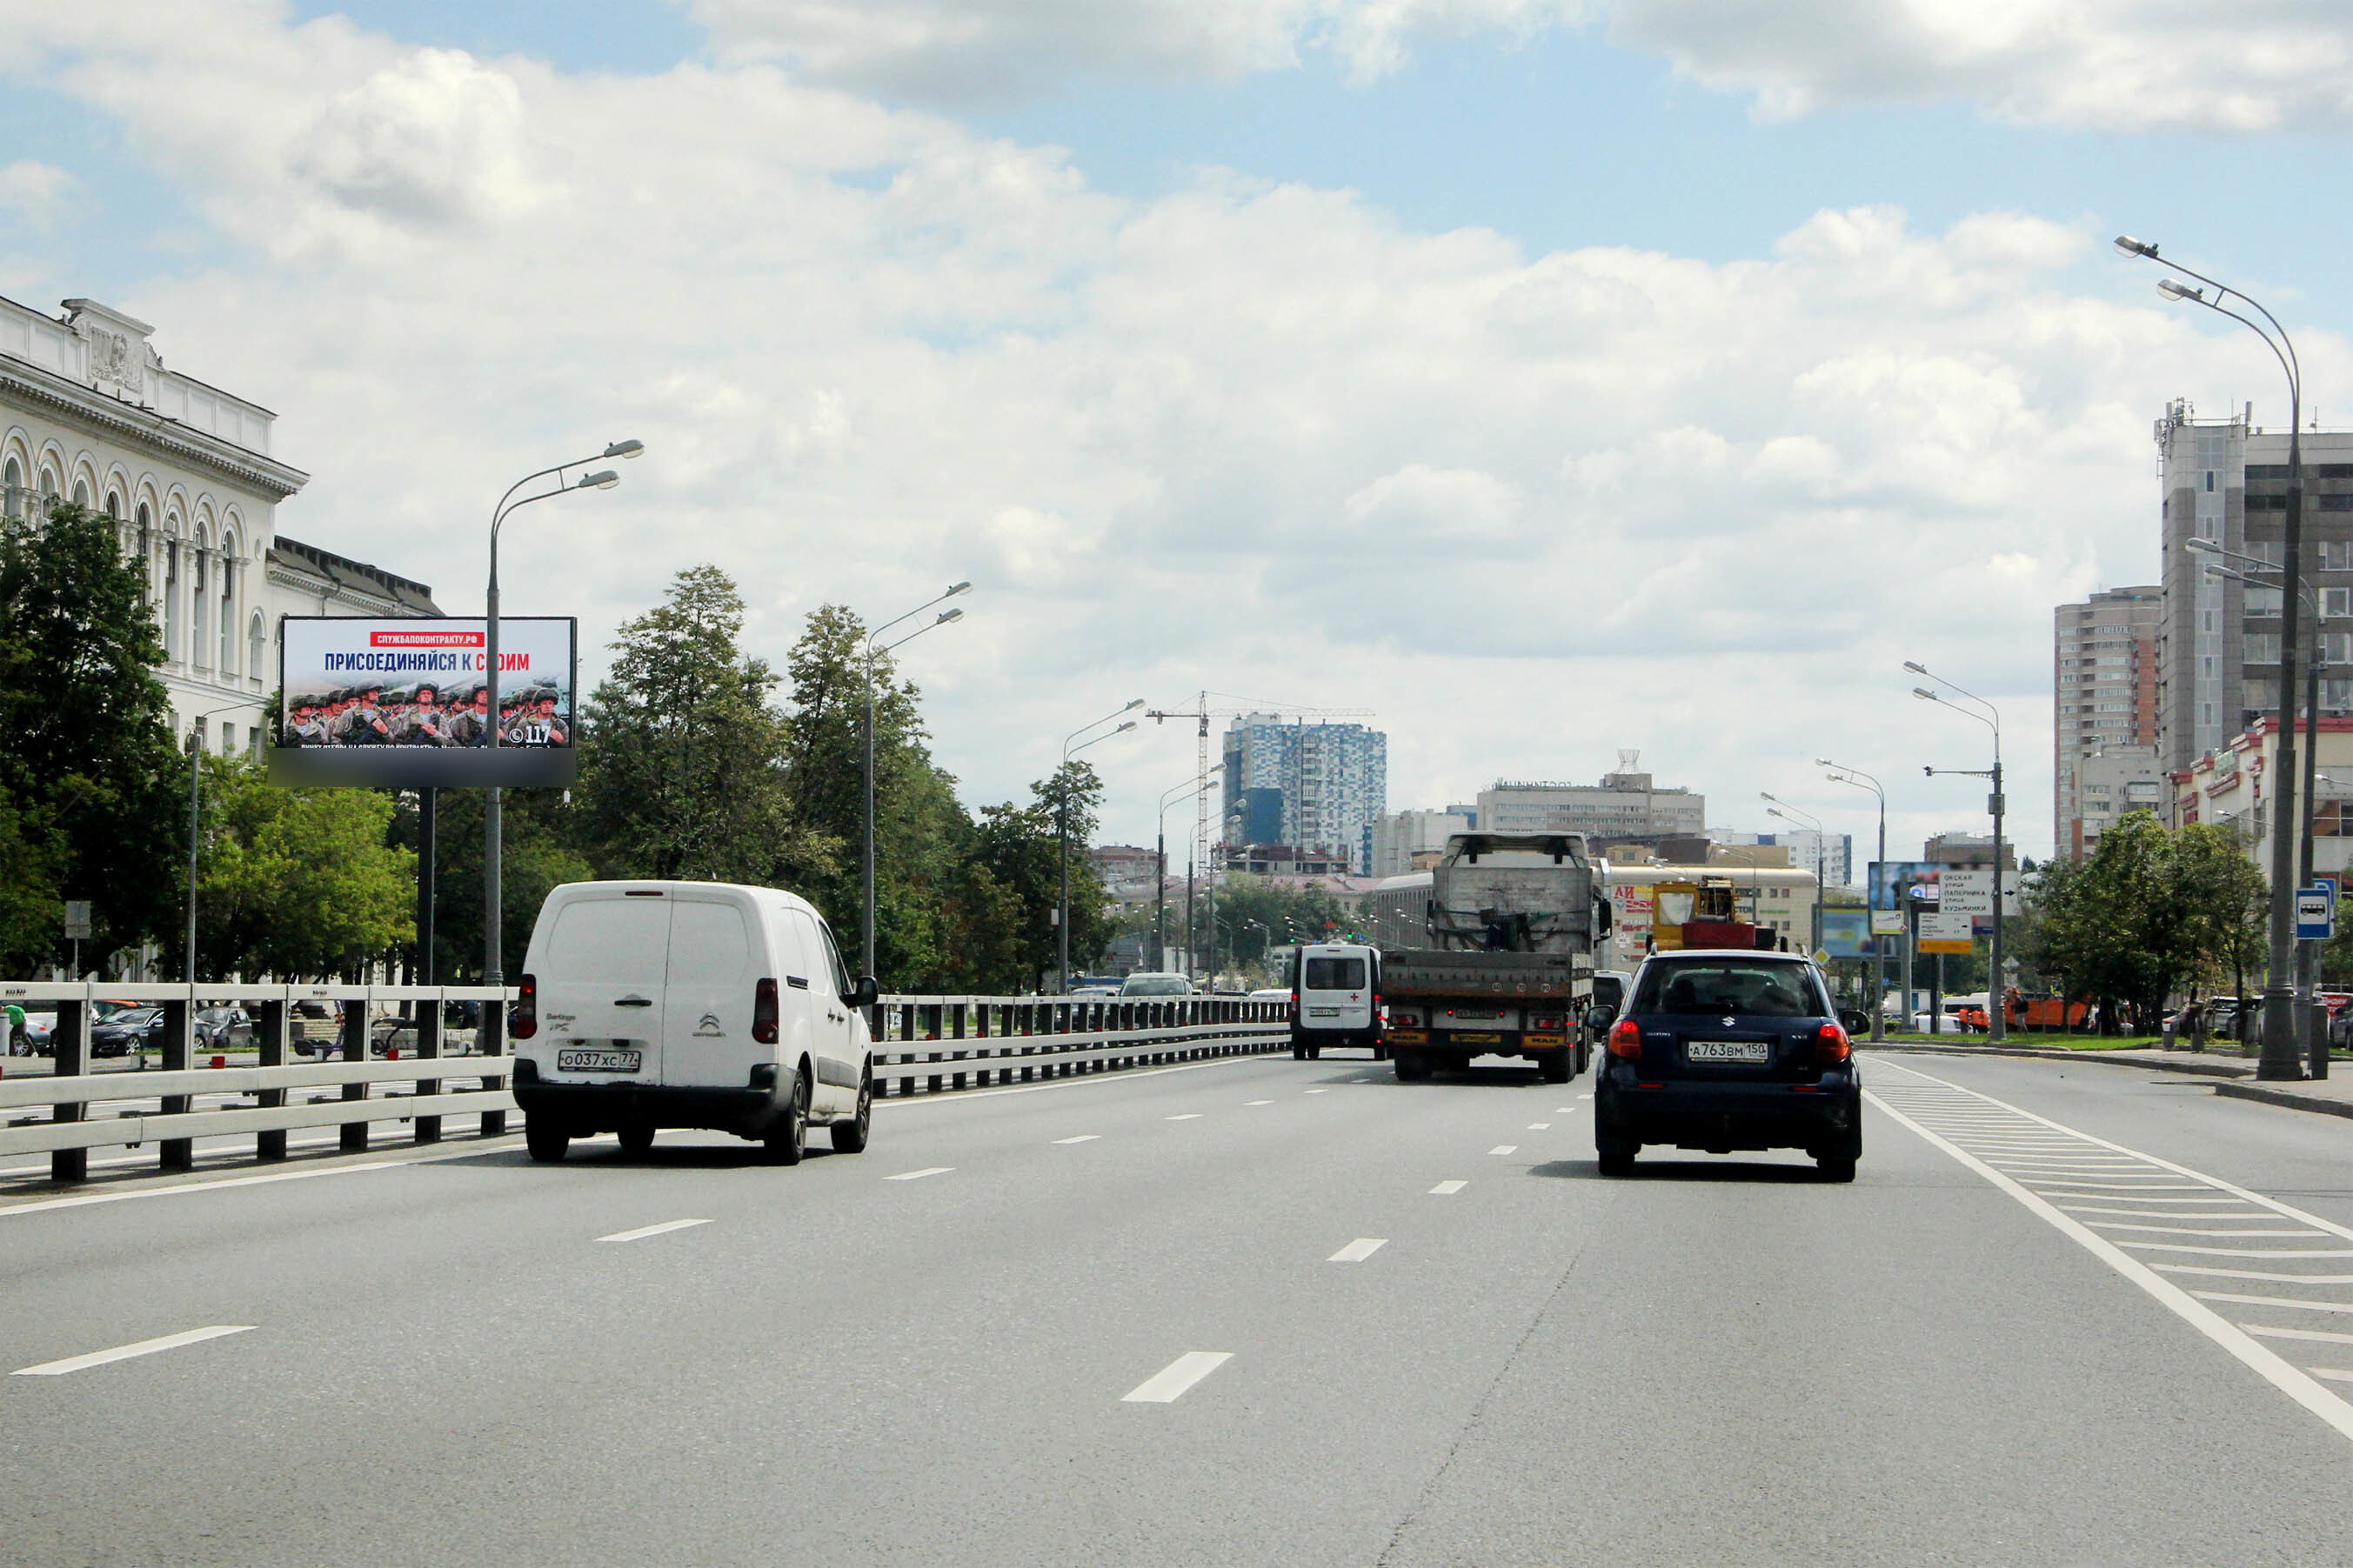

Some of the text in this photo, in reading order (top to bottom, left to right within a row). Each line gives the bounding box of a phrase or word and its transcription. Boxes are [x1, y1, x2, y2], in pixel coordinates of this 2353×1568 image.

[377, 635, 478, 644] СЛУЖБАПОКОНТРАКТУ.РФ
[324, 650, 530, 672] ПРИСОЕДИНЯЙСЯ К СОИМ
[525, 725, 551, 744] 117
